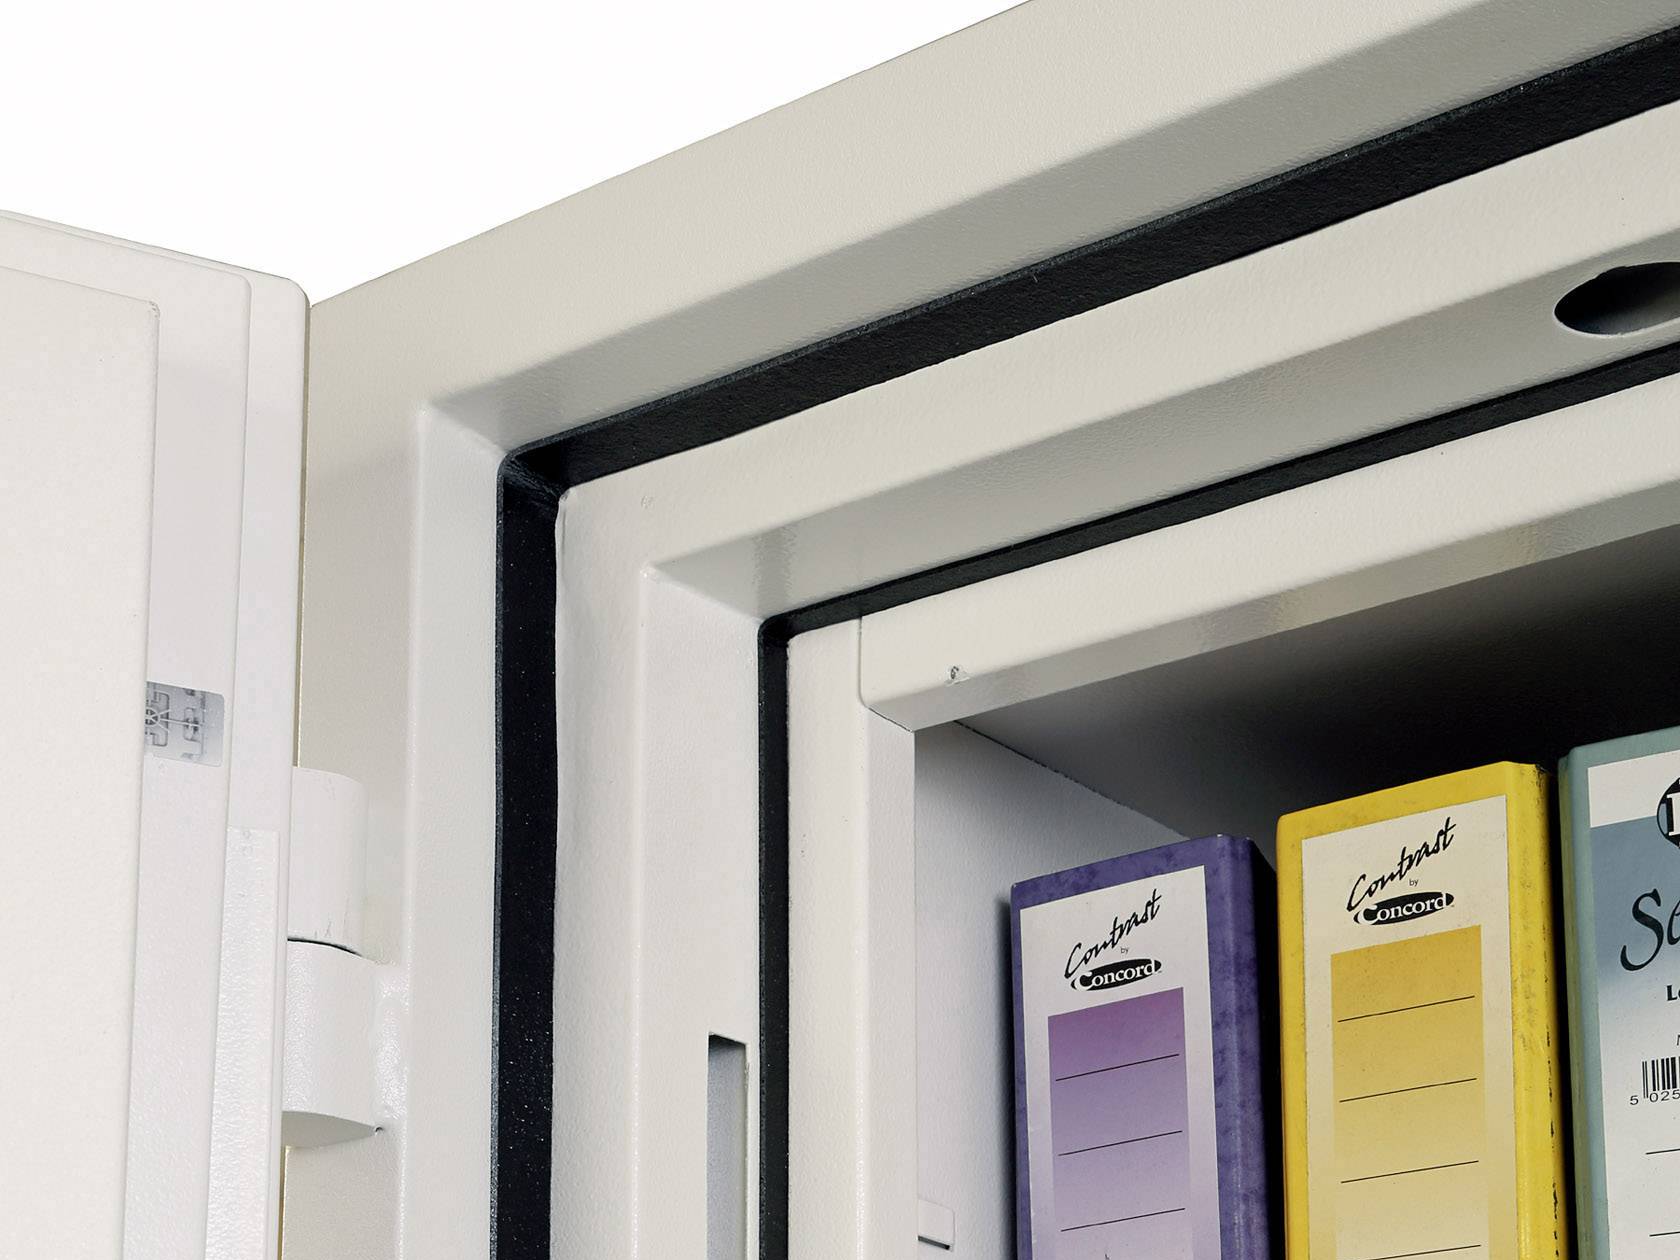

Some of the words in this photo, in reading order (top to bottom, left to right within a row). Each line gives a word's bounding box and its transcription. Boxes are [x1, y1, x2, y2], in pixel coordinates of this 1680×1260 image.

[1346, 816, 1457, 912] Contrast
[1408, 878, 1419, 887] by
[1356, 890, 1448, 926] Concord
[1064, 888, 1162, 979] Contrast
[1120, 946, 1130, 955] by
[1073, 958, 1157, 991] Concord
